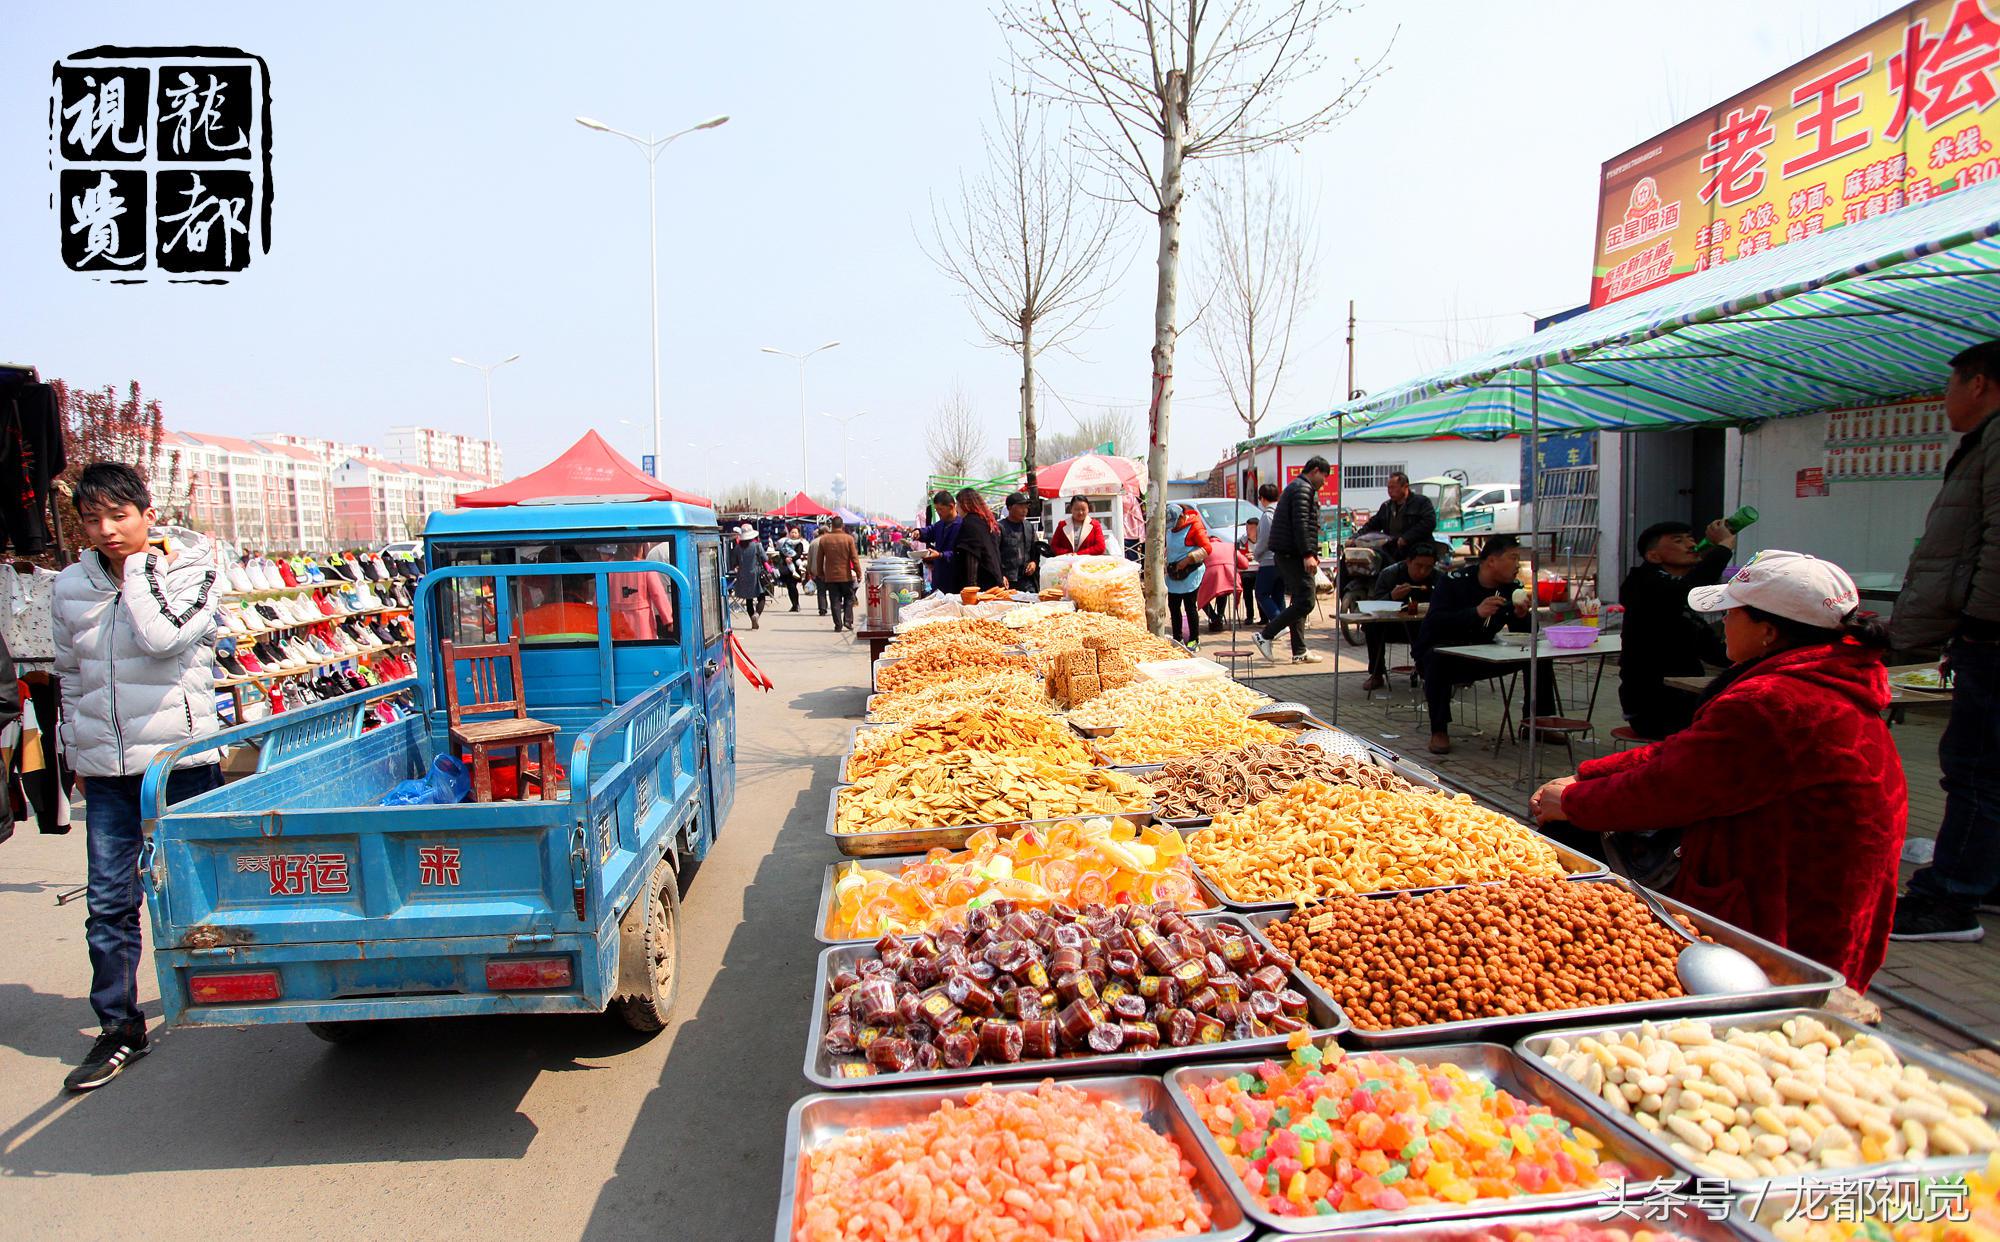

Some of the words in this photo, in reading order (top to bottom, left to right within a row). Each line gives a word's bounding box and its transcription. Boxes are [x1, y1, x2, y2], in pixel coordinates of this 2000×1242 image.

[1697, 0, 2000, 208] 老王烩
[1606, 202, 1679, 250] 金星啤酒
[419, 845, 461, 886] 来
